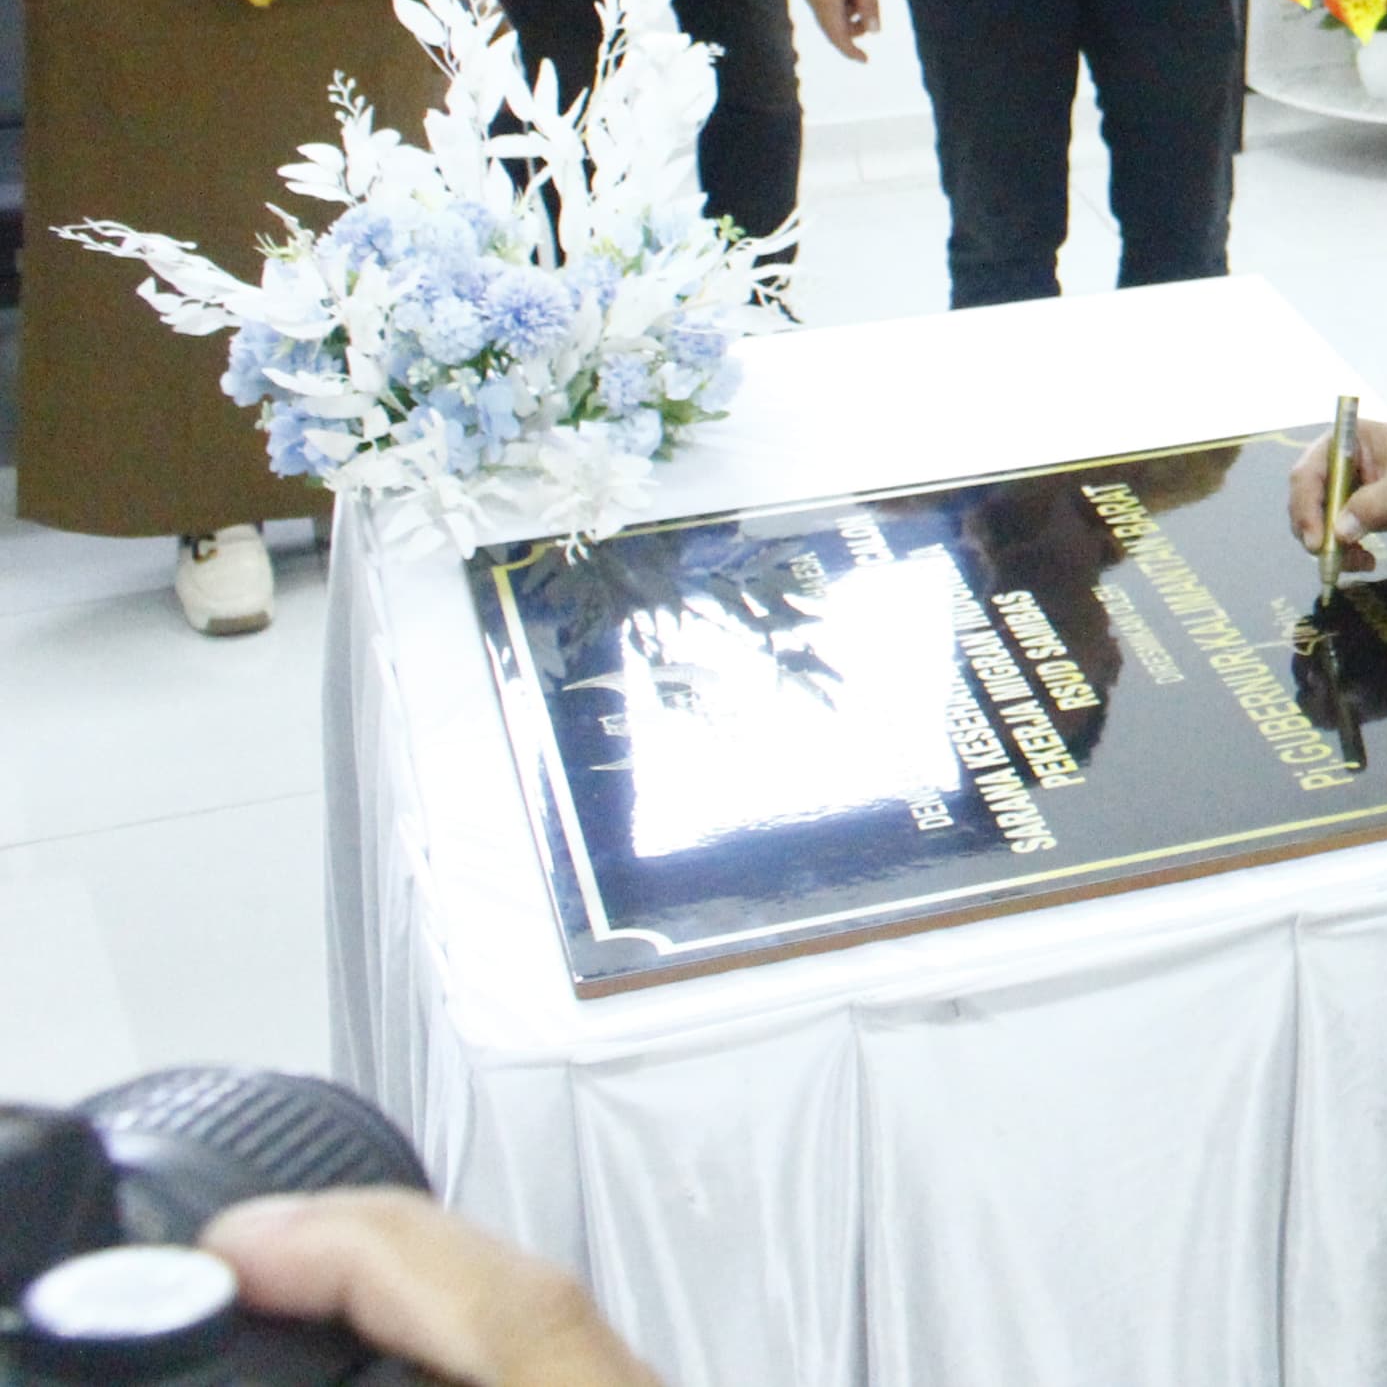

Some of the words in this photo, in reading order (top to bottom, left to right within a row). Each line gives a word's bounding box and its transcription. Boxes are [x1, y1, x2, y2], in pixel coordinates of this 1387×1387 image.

[832, 512, 896, 567] CALON
[1079, 478, 1163, 538] BARAT
[989, 588, 1070, 661] SAMBAS
[1088, 581, 1138, 614] OLEH
[1121, 534, 1248, 651] KALIMANTAN
[956, 629, 1034, 702] MIGRAN
[1031, 657, 1102, 711] RSUD
[1111, 611, 1188, 685] DIRESMIKAN
[996, 698, 1087, 790] PEKERJA
[971, 766, 1059, 855] SARANA
